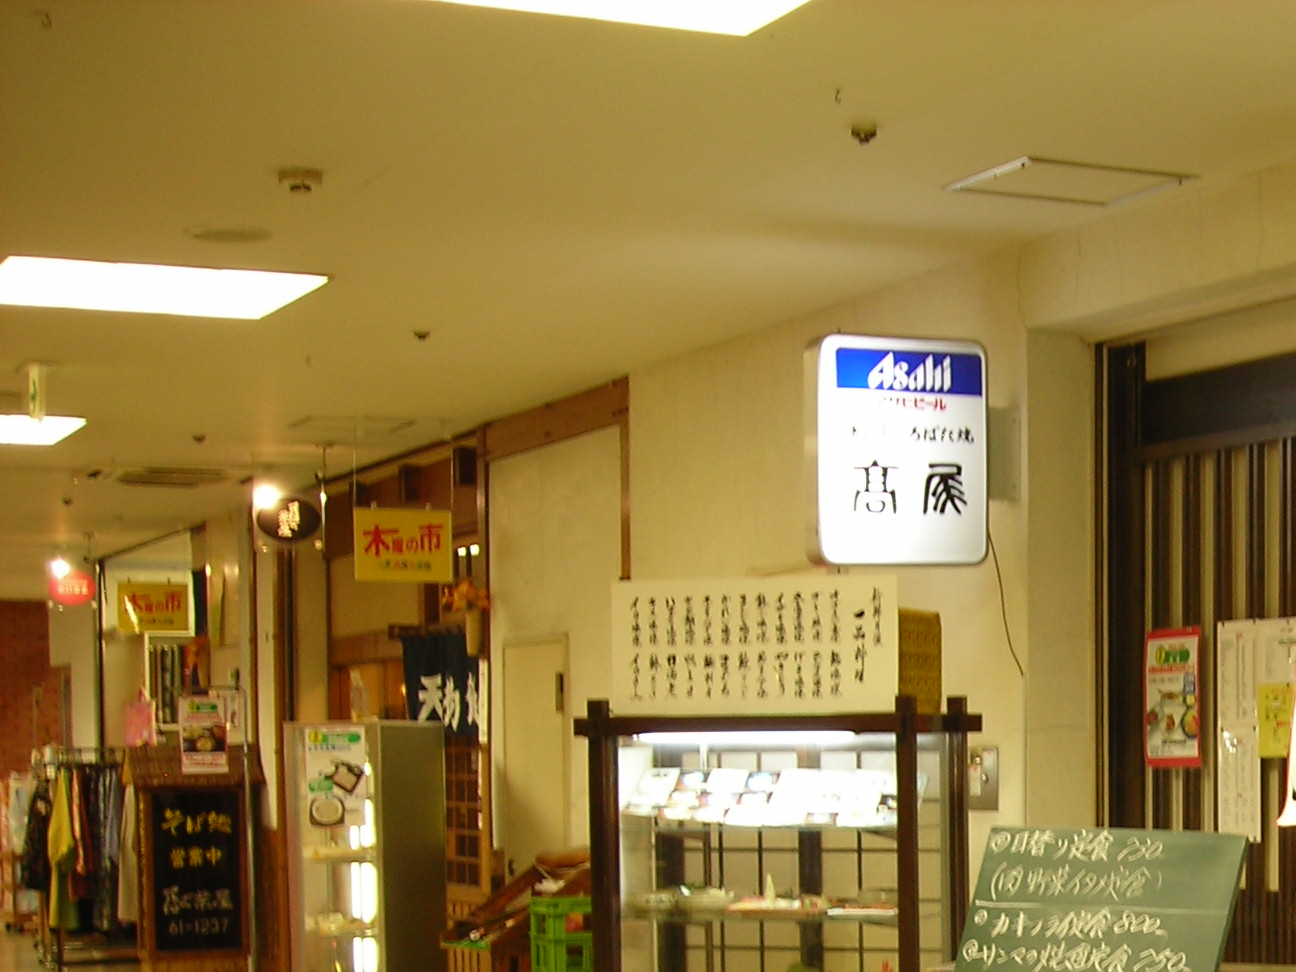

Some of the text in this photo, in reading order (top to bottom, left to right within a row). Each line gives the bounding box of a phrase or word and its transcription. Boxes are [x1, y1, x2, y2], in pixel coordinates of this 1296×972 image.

[867, 351, 951, 392] Asahi
[170, 846, 222, 869] 営業中
